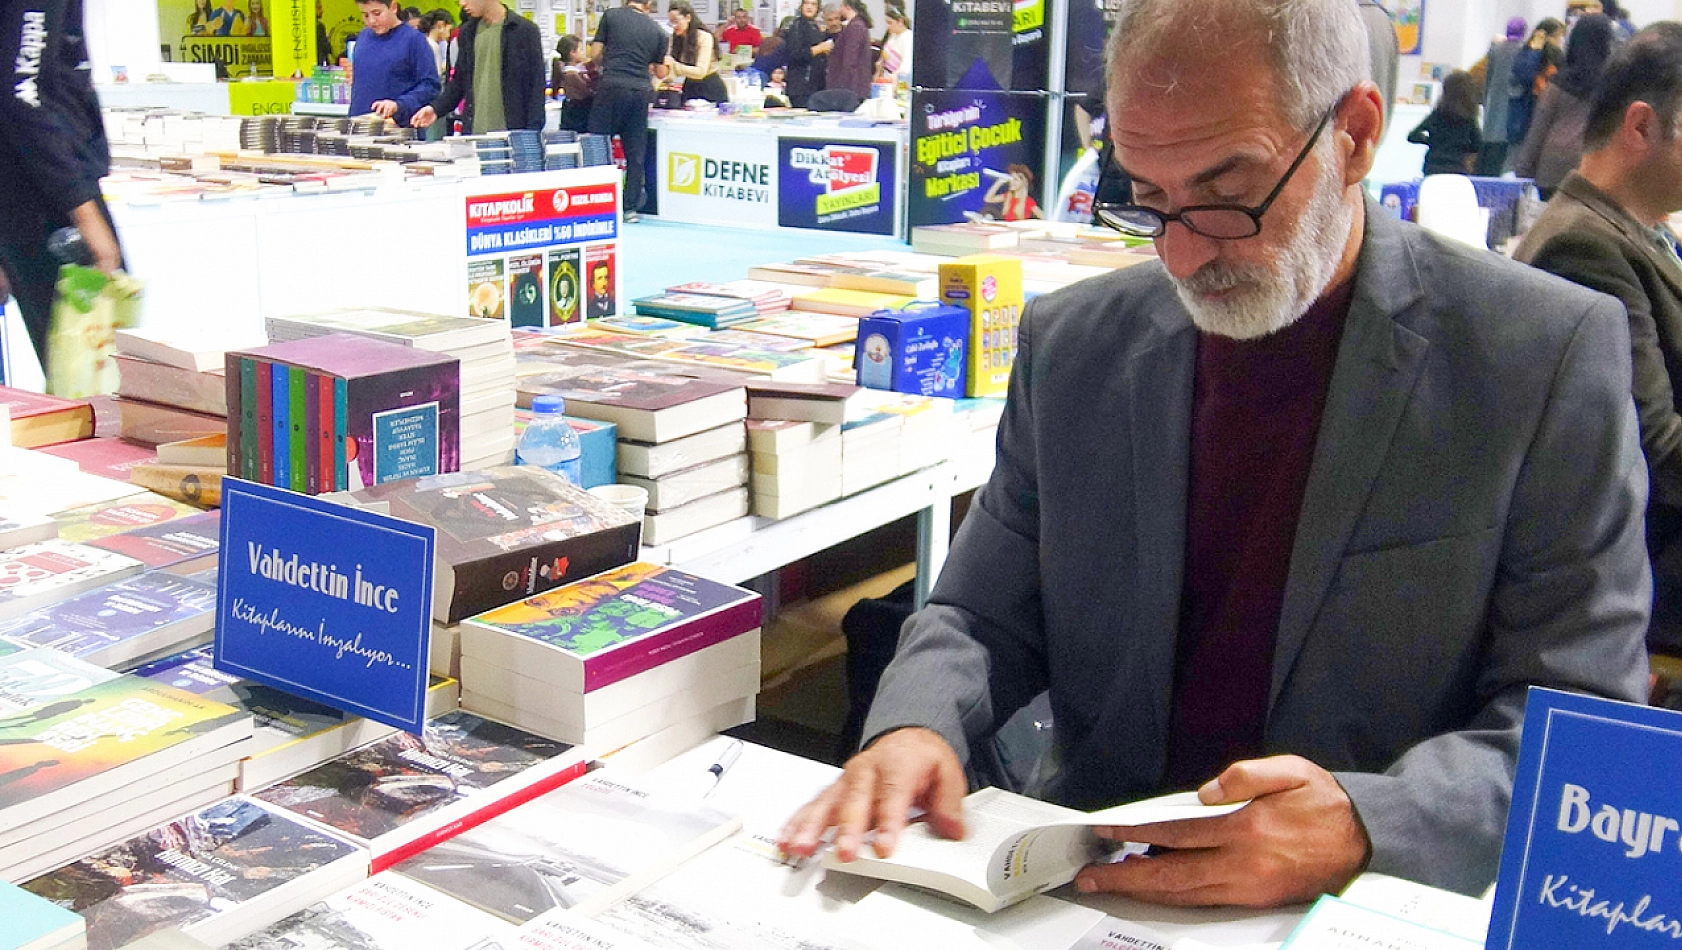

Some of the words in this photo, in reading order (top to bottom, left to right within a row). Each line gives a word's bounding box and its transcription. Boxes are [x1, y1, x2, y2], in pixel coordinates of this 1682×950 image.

[14, 11, 48, 75] Kappa
[917, 128, 967, 166] Eğitici
[970, 117, 1022, 156] Çocuk
[704, 158, 769, 186] DEFNE
[796, 152, 845, 167] Dikkat
[814, 169, 871, 184] Atölyesi
[925, 171, 979, 198] Markası
[822, 193, 875, 208] YAYINLARI
[471, 232, 502, 250] DÜNYA
[504, 224, 553, 246] KLASİKLERİ
[553, 225, 571, 240] %60
[248, 541, 348, 600] Vahdettin
[354, 563, 399, 613] İnce
[231, 598, 315, 641] Kitaplarını
[1557, 783, 1682, 858] Bayr
